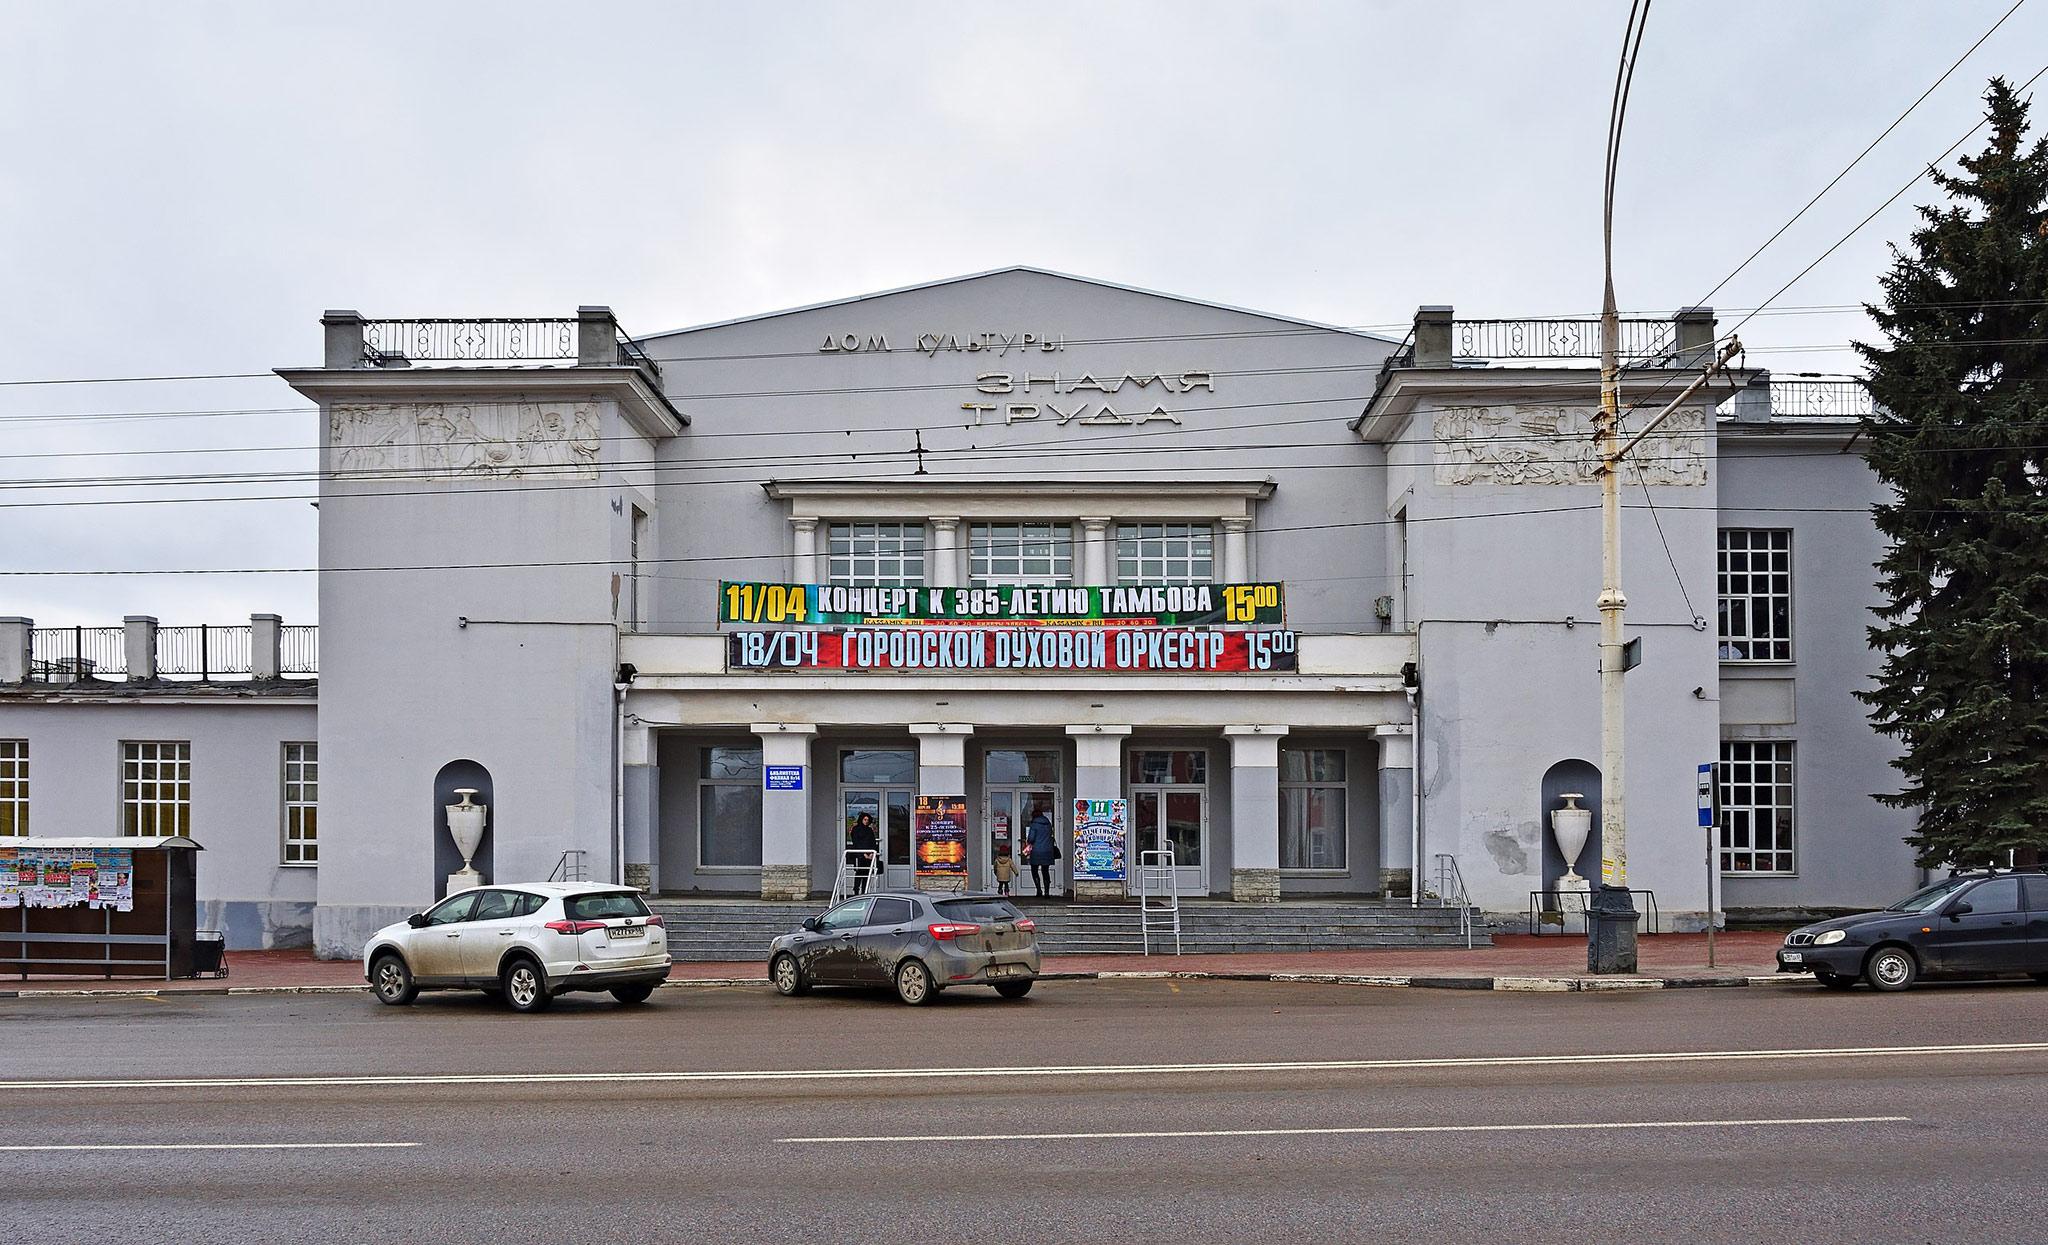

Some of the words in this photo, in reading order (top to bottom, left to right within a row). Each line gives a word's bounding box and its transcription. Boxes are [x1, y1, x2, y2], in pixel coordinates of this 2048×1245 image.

[819, 333, 892, 352] ДОМ
[915, 333, 1066, 357] КУЛЬТУРЫ
[976, 370, 1216, 394] ЗНАМЯ
[961, 402, 1183, 426] ТРУДА
[726, 585, 807, 623] 11/04
[817, 586, 919, 617] КОНЦЕРТ
[929, 588, 945, 615] К
[955, 588, 1089, 615] 385-ЛЕТИЮ
[1099, 586, 1213, 614] ТАМБОВА
[737, 631, 819, 667] 18/04
[842, 630, 985, 667] ГОРОДСКОЙ
[995, 630, 1106, 668] ДУХОВОЙ
[1116, 631, 1225, 668] ОРКЕСТР
[918, 796, 928, 805] 18
[1095, 802, 1105, 812] 11
